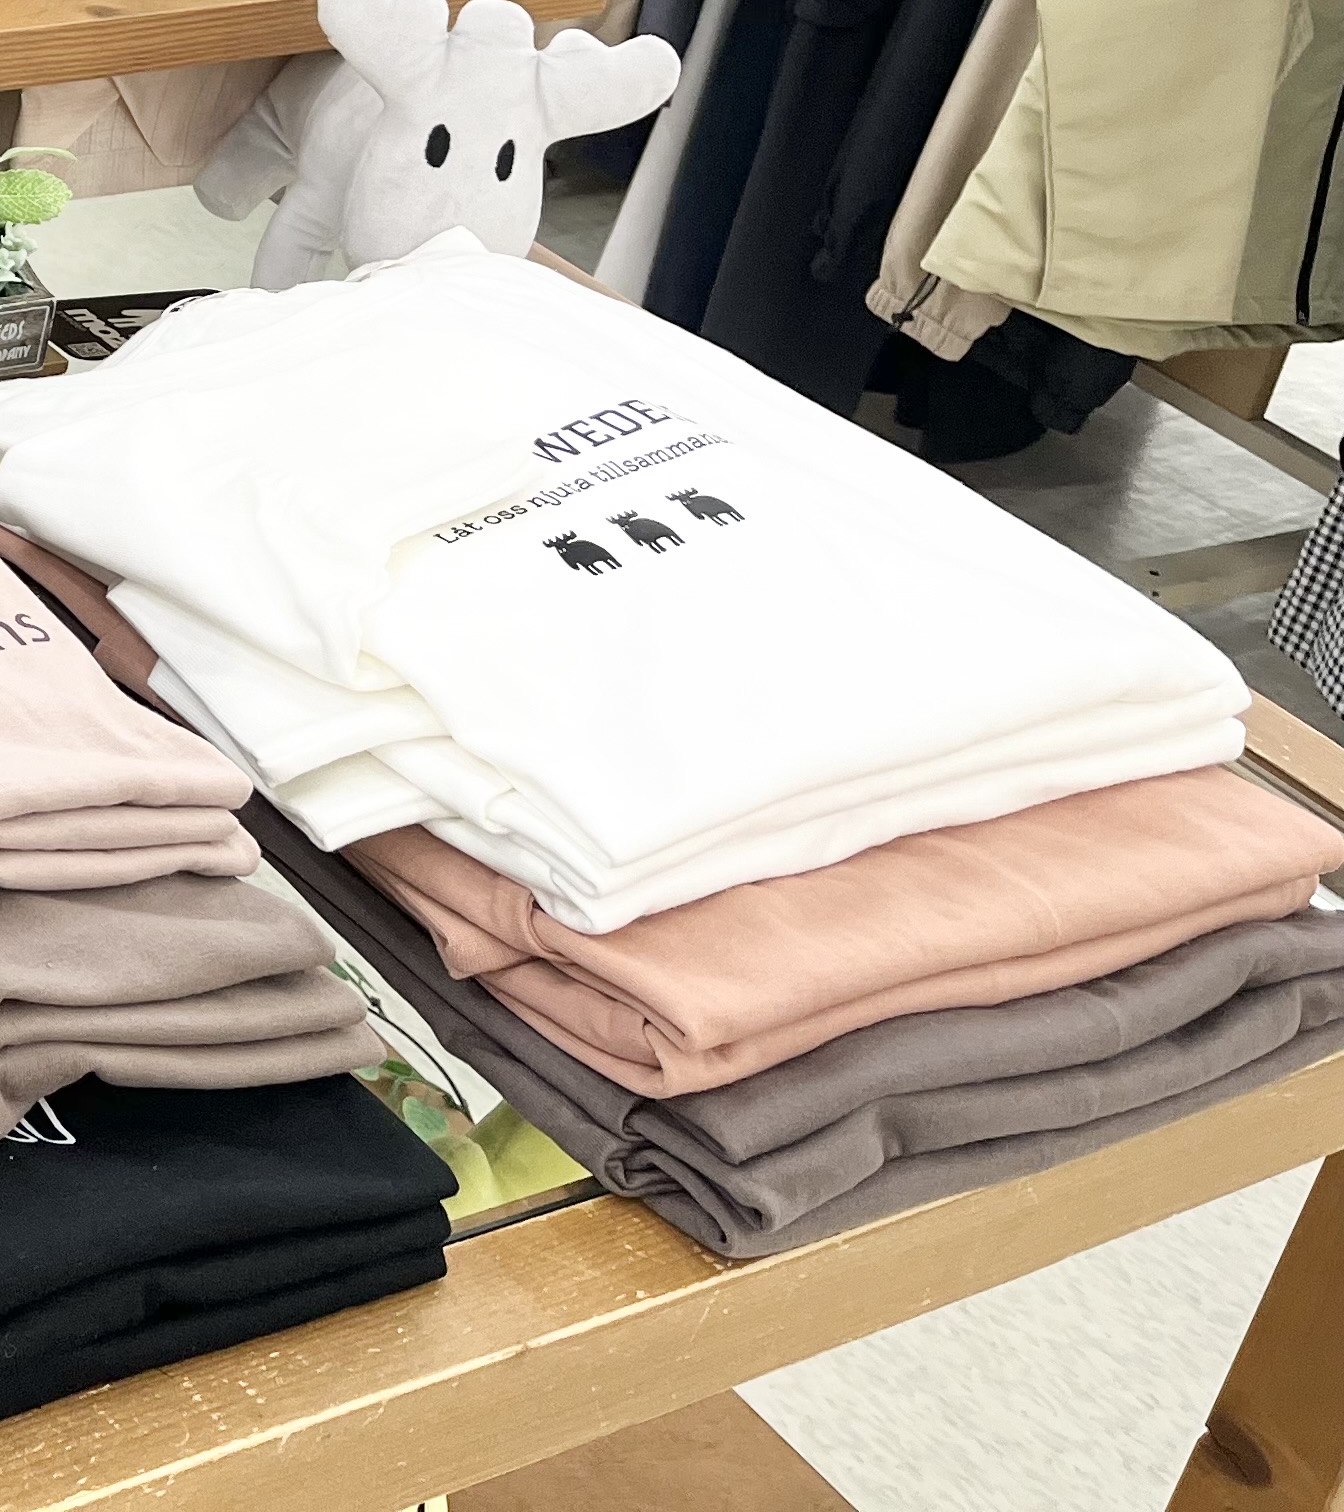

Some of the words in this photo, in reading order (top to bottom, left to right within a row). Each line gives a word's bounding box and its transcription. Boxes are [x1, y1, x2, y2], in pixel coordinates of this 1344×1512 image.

[433, 520, 485, 546] Låt
[483, 501, 530, 526] oss
[527, 475, 596, 508] njuta
